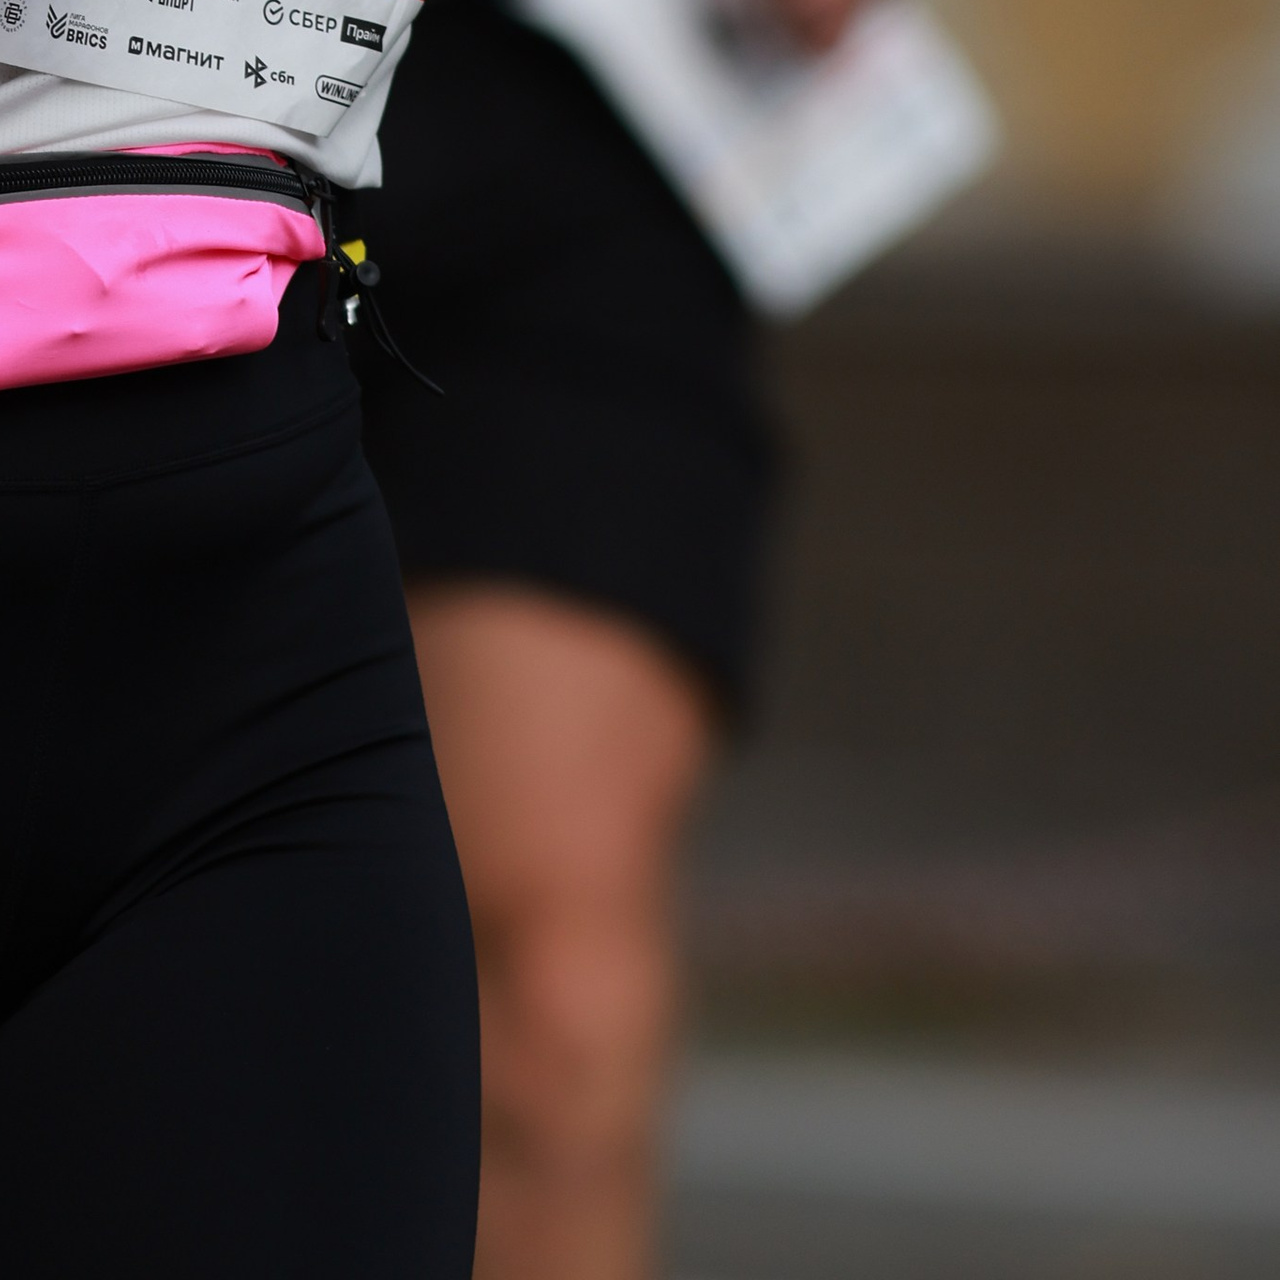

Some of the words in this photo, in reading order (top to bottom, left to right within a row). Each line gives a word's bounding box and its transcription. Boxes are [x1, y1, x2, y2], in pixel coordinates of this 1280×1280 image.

[289, 9, 337, 34] СБЕР
[66, 28, 107, 50] BRICS
[270, 70, 295, 86] сбп
